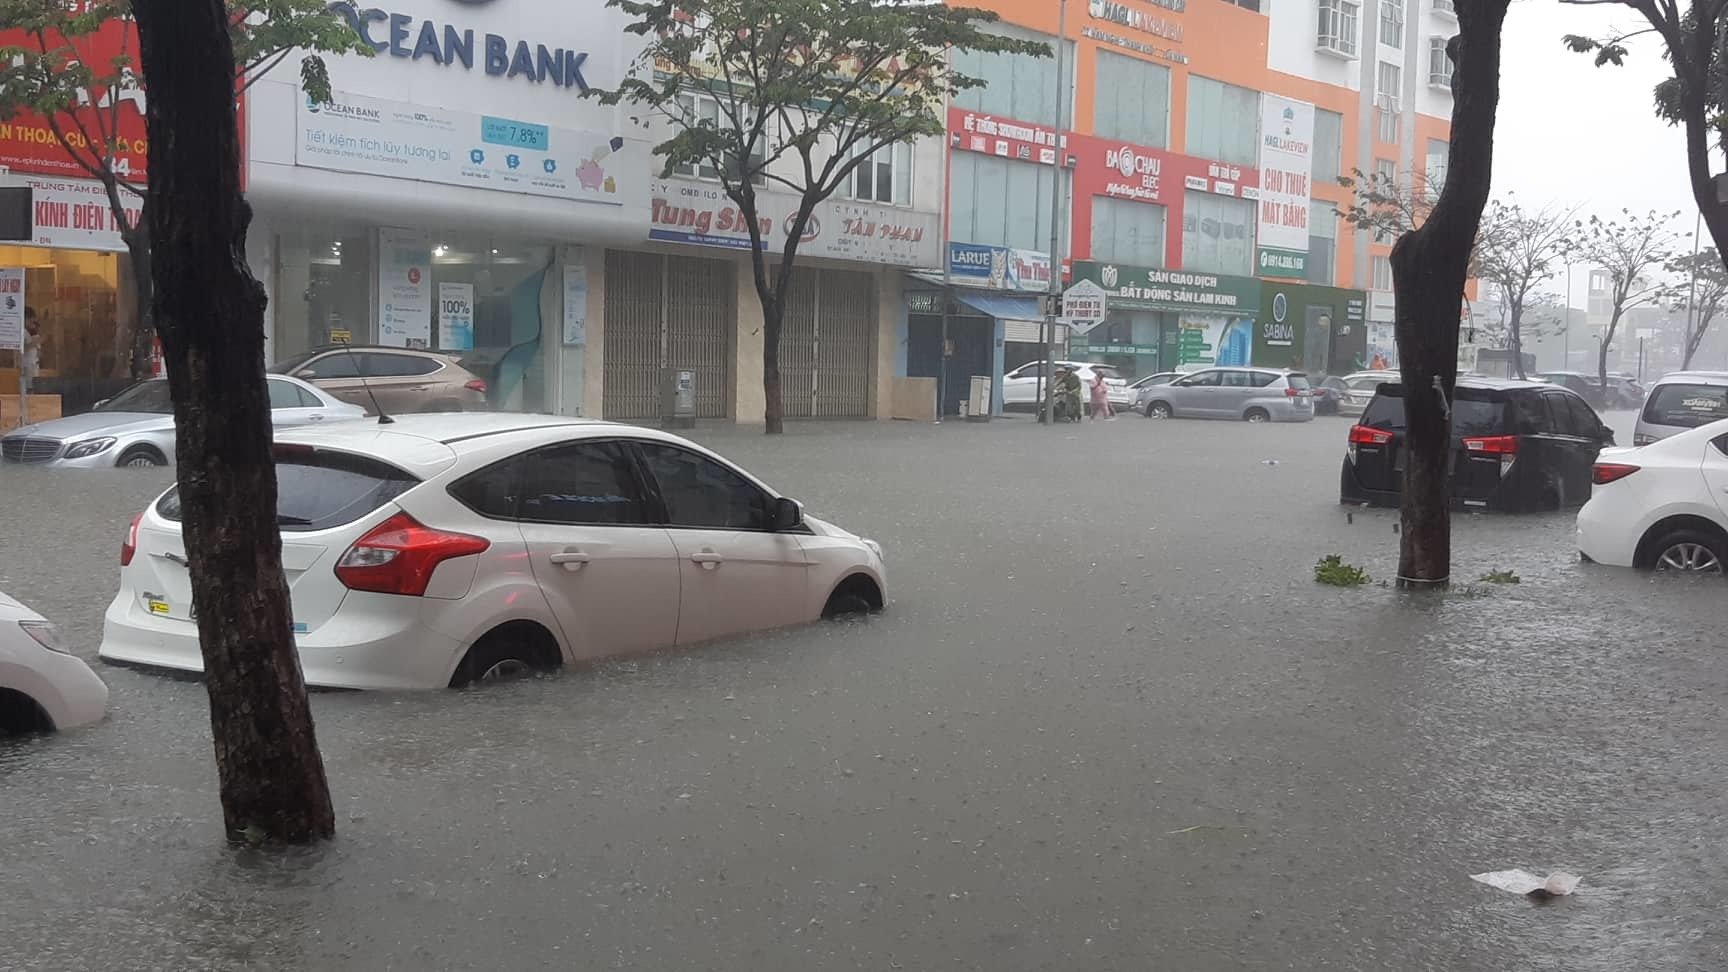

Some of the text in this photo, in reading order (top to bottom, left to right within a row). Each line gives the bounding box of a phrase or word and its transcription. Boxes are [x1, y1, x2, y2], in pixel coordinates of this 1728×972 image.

[485, 33, 589, 90] BANK
[323, 102, 355, 115] OCEAN
[356, 108, 380, 118] BANK
[26, 181, 65, 192] TRUNG
[67, 184, 90, 194] TÂM
[1264, 168, 1282, 193] CHO
[1285, 171, 1307, 197] THUÊ
[35, 196, 68, 228] KÍNH
[73, 201, 104, 234] ĐIỆN
[651, 198, 772, 238] Tung Shn
[951, 249, 990, 265] LARUE
[1170, 273, 1193, 285] GIAO
[1194, 276, 1217, 288] DỊCH
[1120, 281, 1142, 298] BẤT
[1173, 287, 1193, 303] SẢN
[1194, 294, 1214, 304] LAM
[1215, 295, 1237, 305] KINH
[442, 299, 471, 315] 100%
[1263, 323, 1294, 340] SABINA
